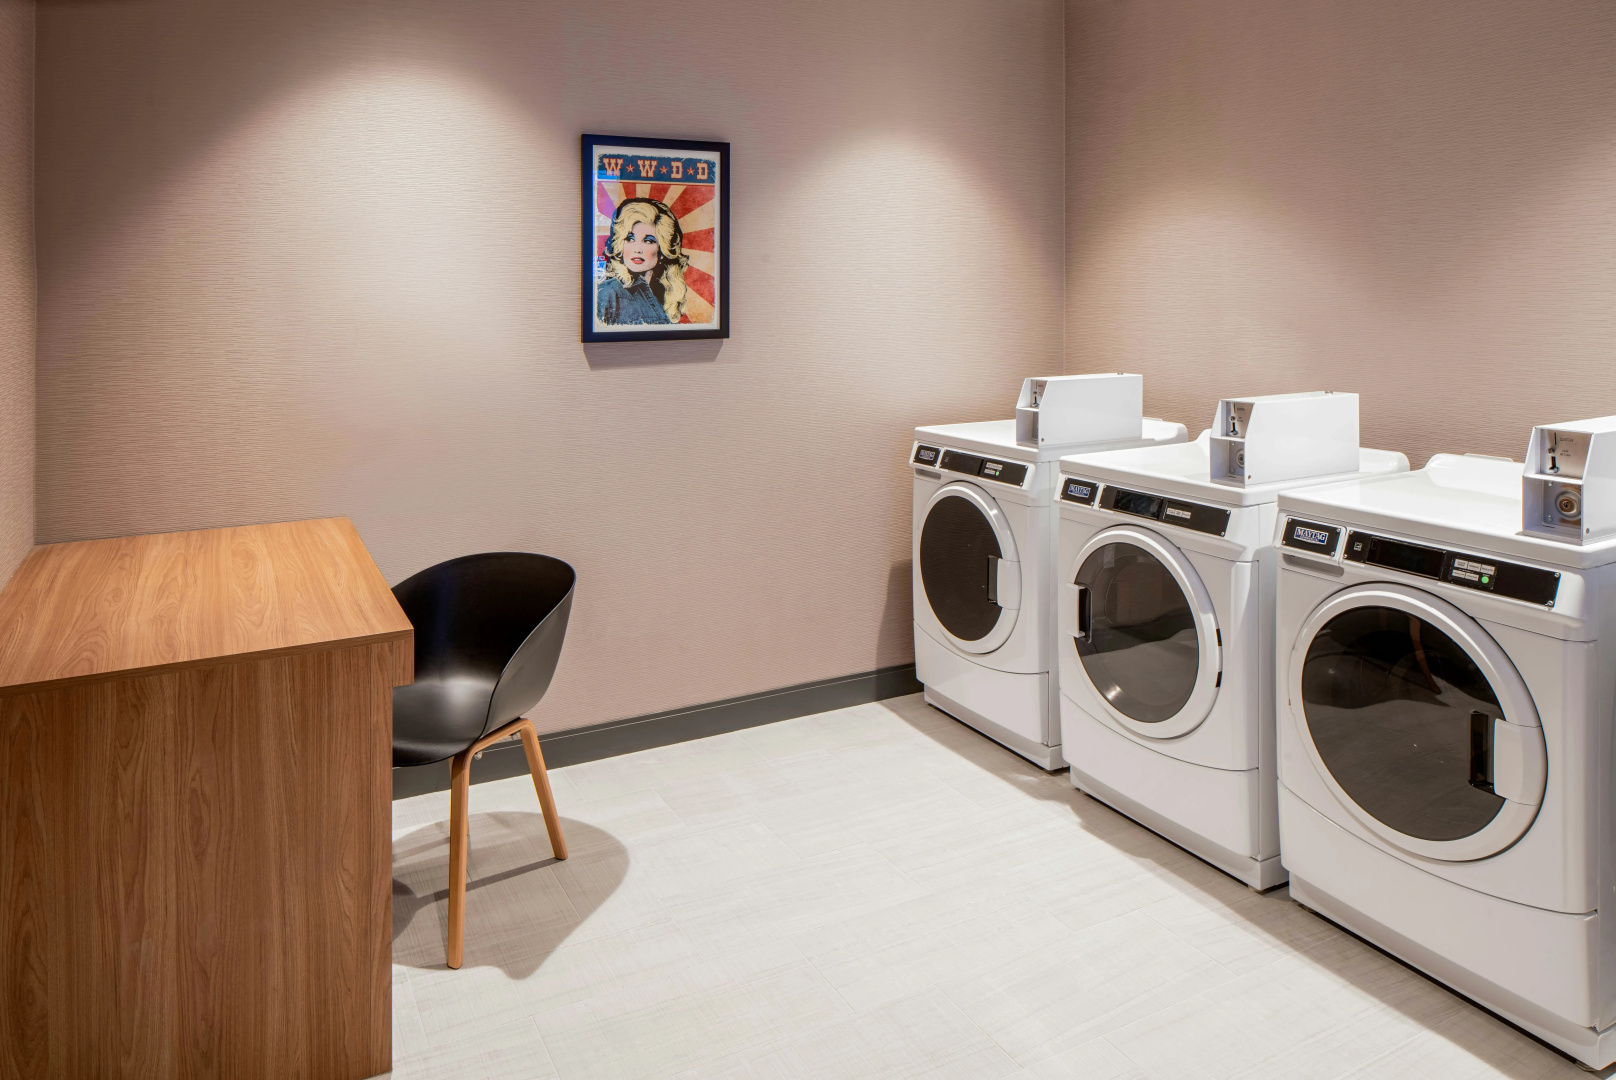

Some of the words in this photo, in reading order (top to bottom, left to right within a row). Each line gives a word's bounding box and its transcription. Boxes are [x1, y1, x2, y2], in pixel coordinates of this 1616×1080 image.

[602, 158, 624, 176] W
[637, 160, 658, 178] W
[670, 161, 683, 179] D
[696, 162, 709, 180] D
[1296, 528, 1326, 541] MAYTAG
